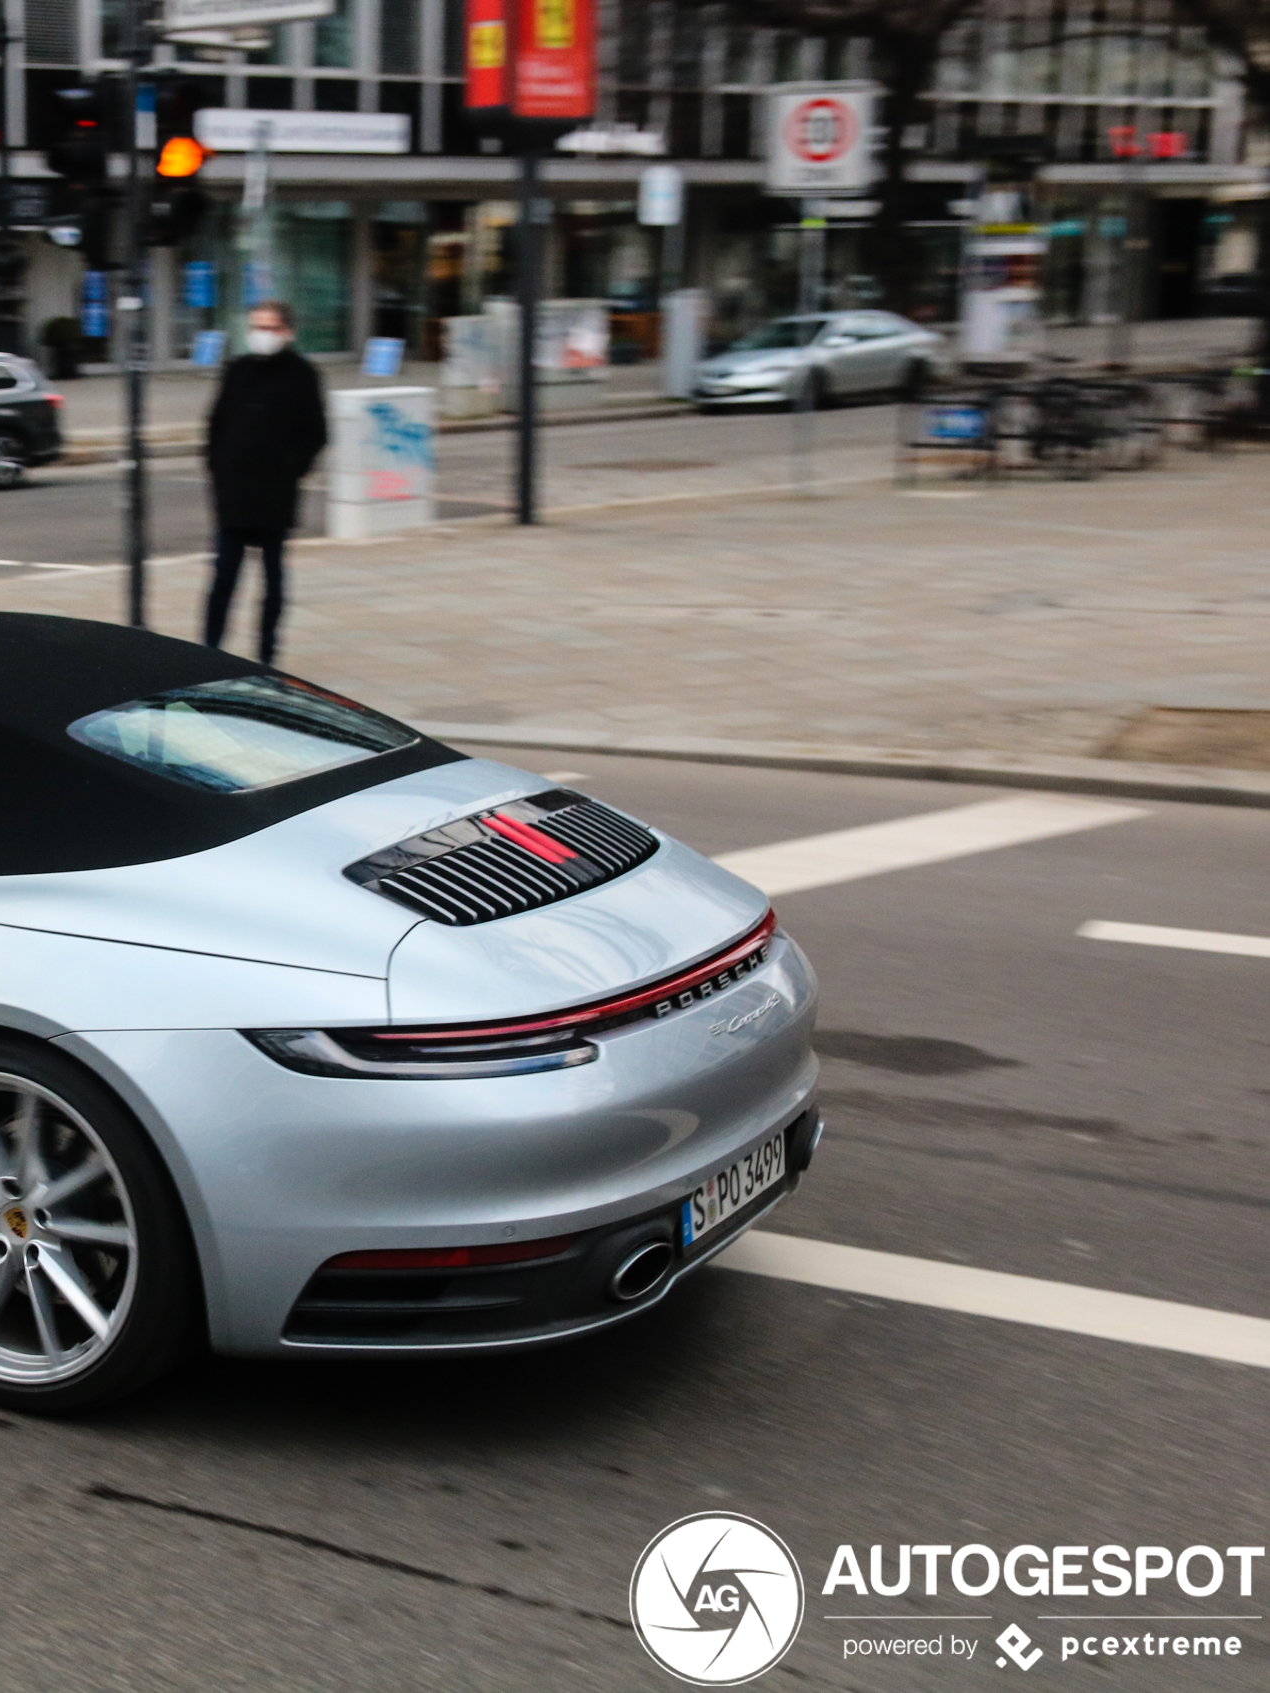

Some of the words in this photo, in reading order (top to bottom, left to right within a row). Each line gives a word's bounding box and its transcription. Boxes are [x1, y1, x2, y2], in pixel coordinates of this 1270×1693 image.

[654, 944, 770, 1019] PORSCHE
[693, 1186, 706, 1231] S
[717, 1164, 741, 1216] PO
[743, 1133, 783, 1196] 3499
